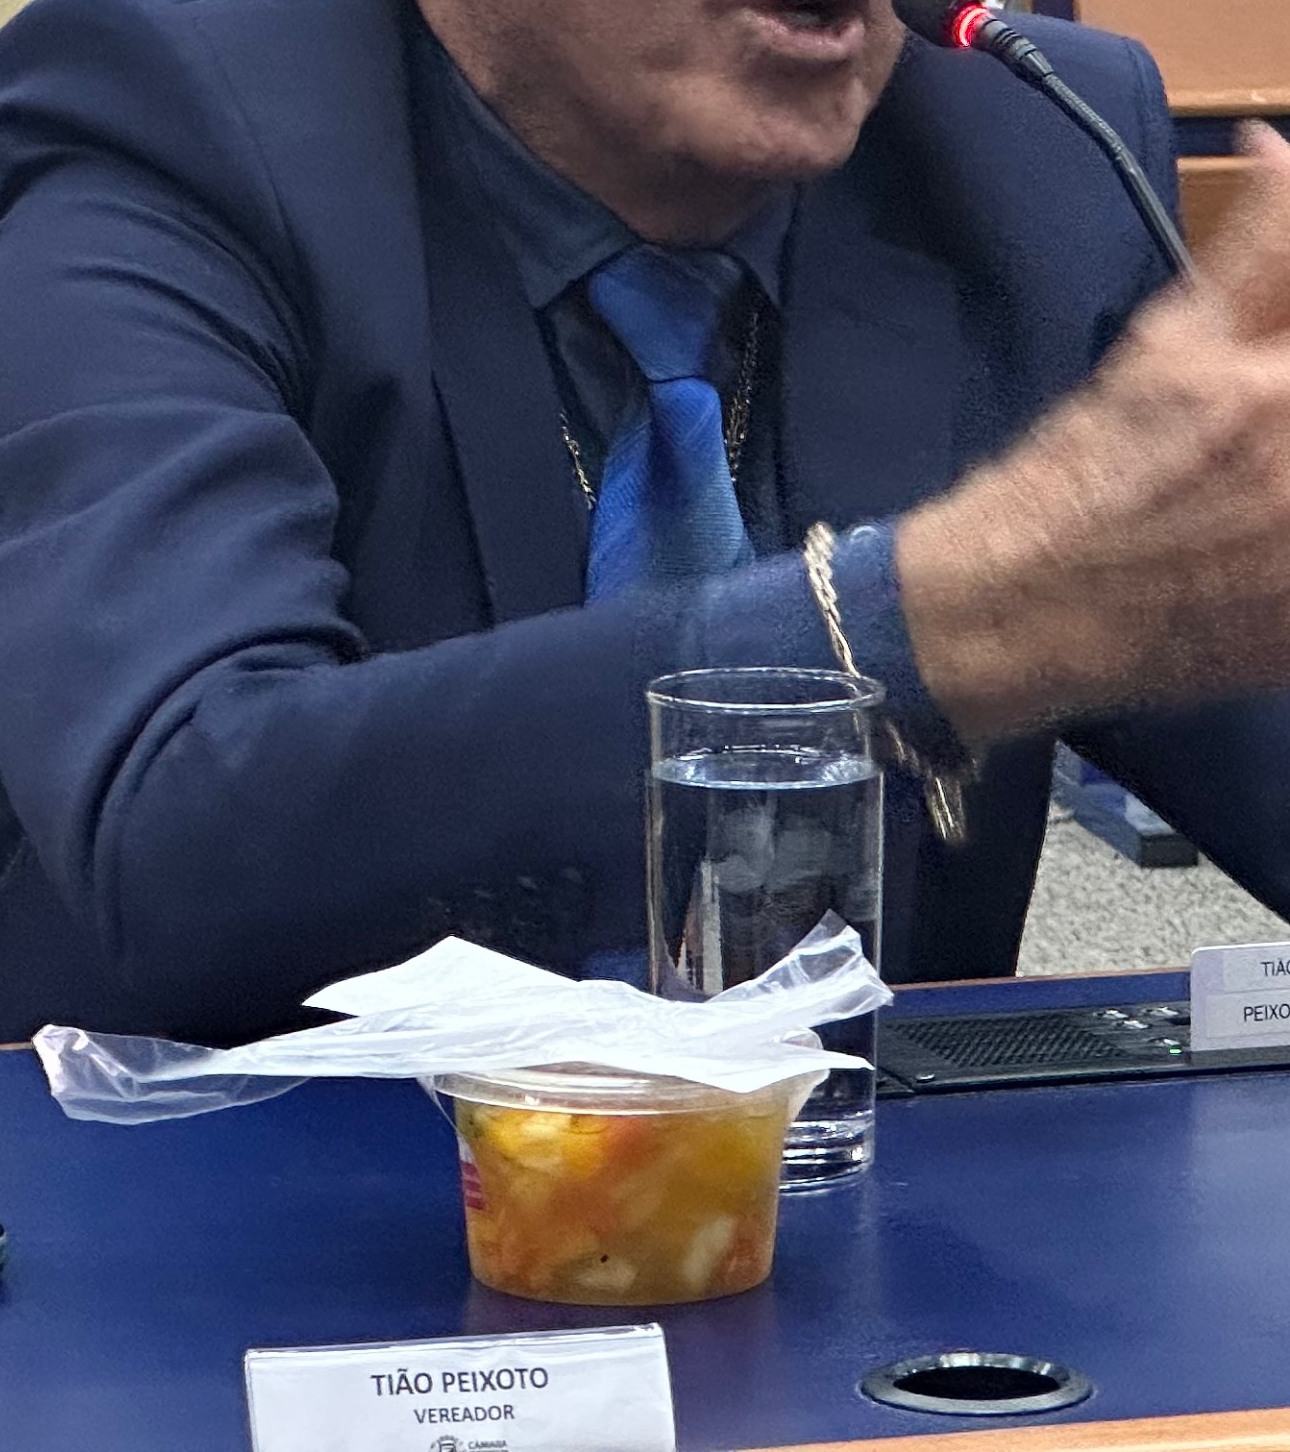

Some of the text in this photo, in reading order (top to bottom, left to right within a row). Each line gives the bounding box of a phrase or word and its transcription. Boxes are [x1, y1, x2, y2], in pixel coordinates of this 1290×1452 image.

[370, 1367, 549, 1397] TIÃO PEIXOTO
[413, 1404, 515, 1424] VEREADOR
